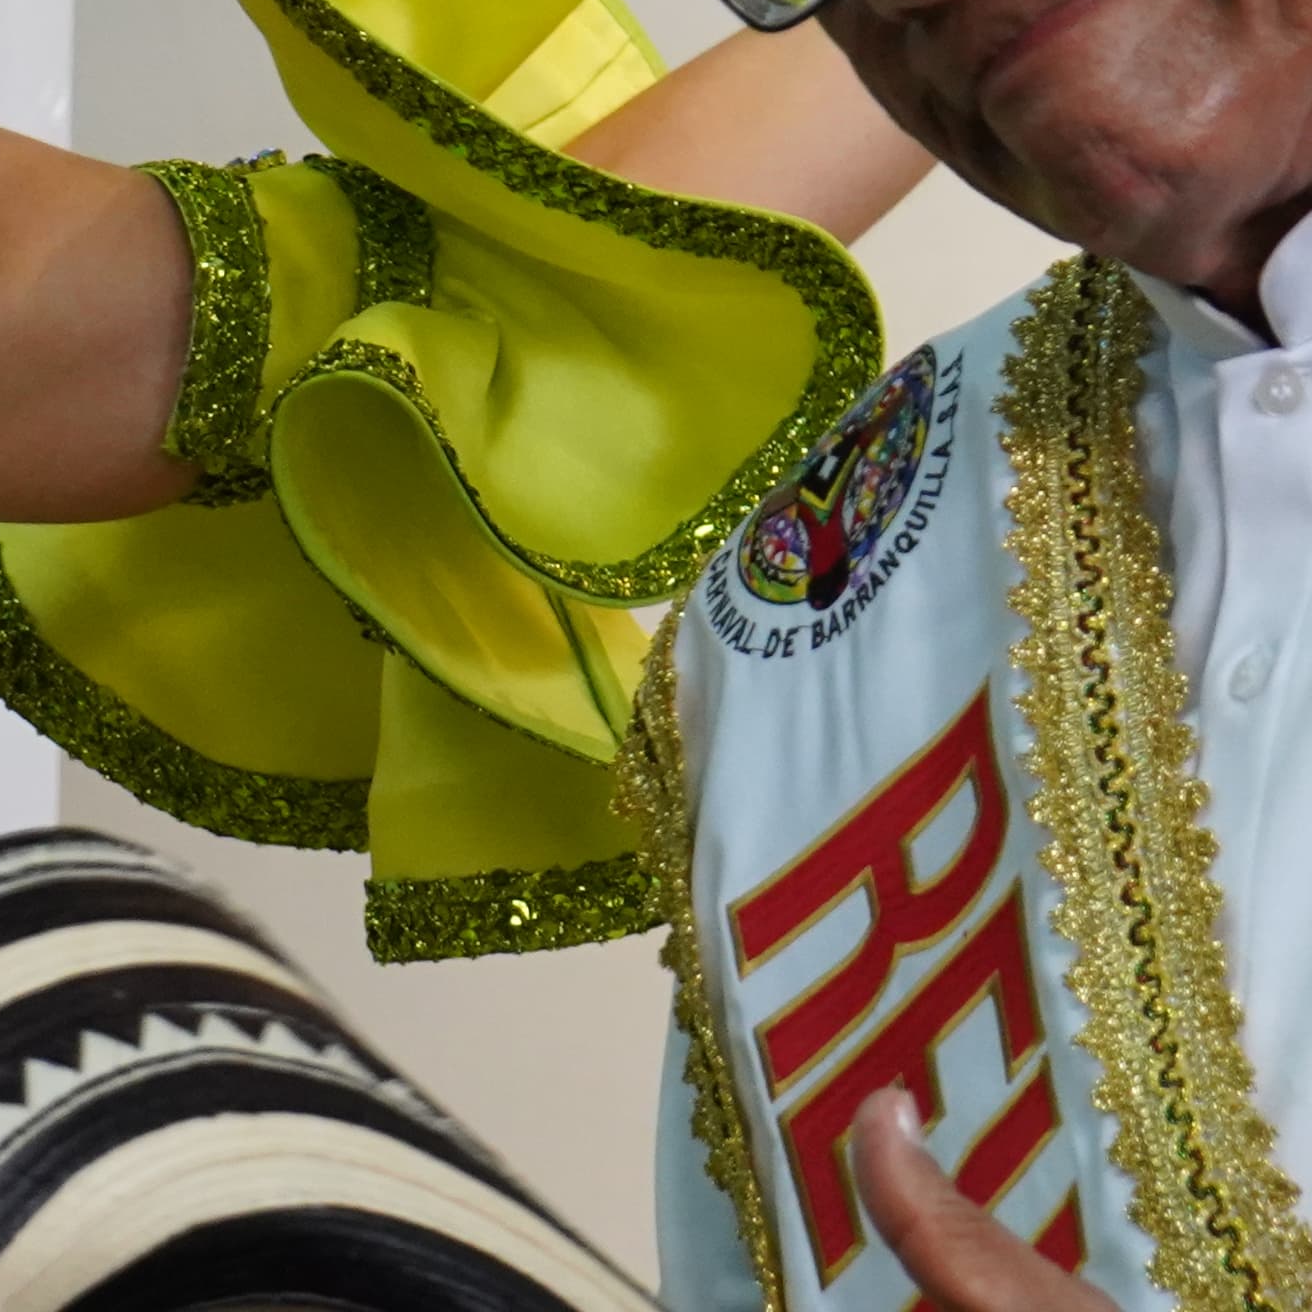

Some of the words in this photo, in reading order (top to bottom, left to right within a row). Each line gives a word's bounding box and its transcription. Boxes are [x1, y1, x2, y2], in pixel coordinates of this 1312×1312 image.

[706, 549, 754, 655] CARNAVAL
[761, 627, 799, 658] DE
[811, 438, 954, 650] BARRANQUILLA
